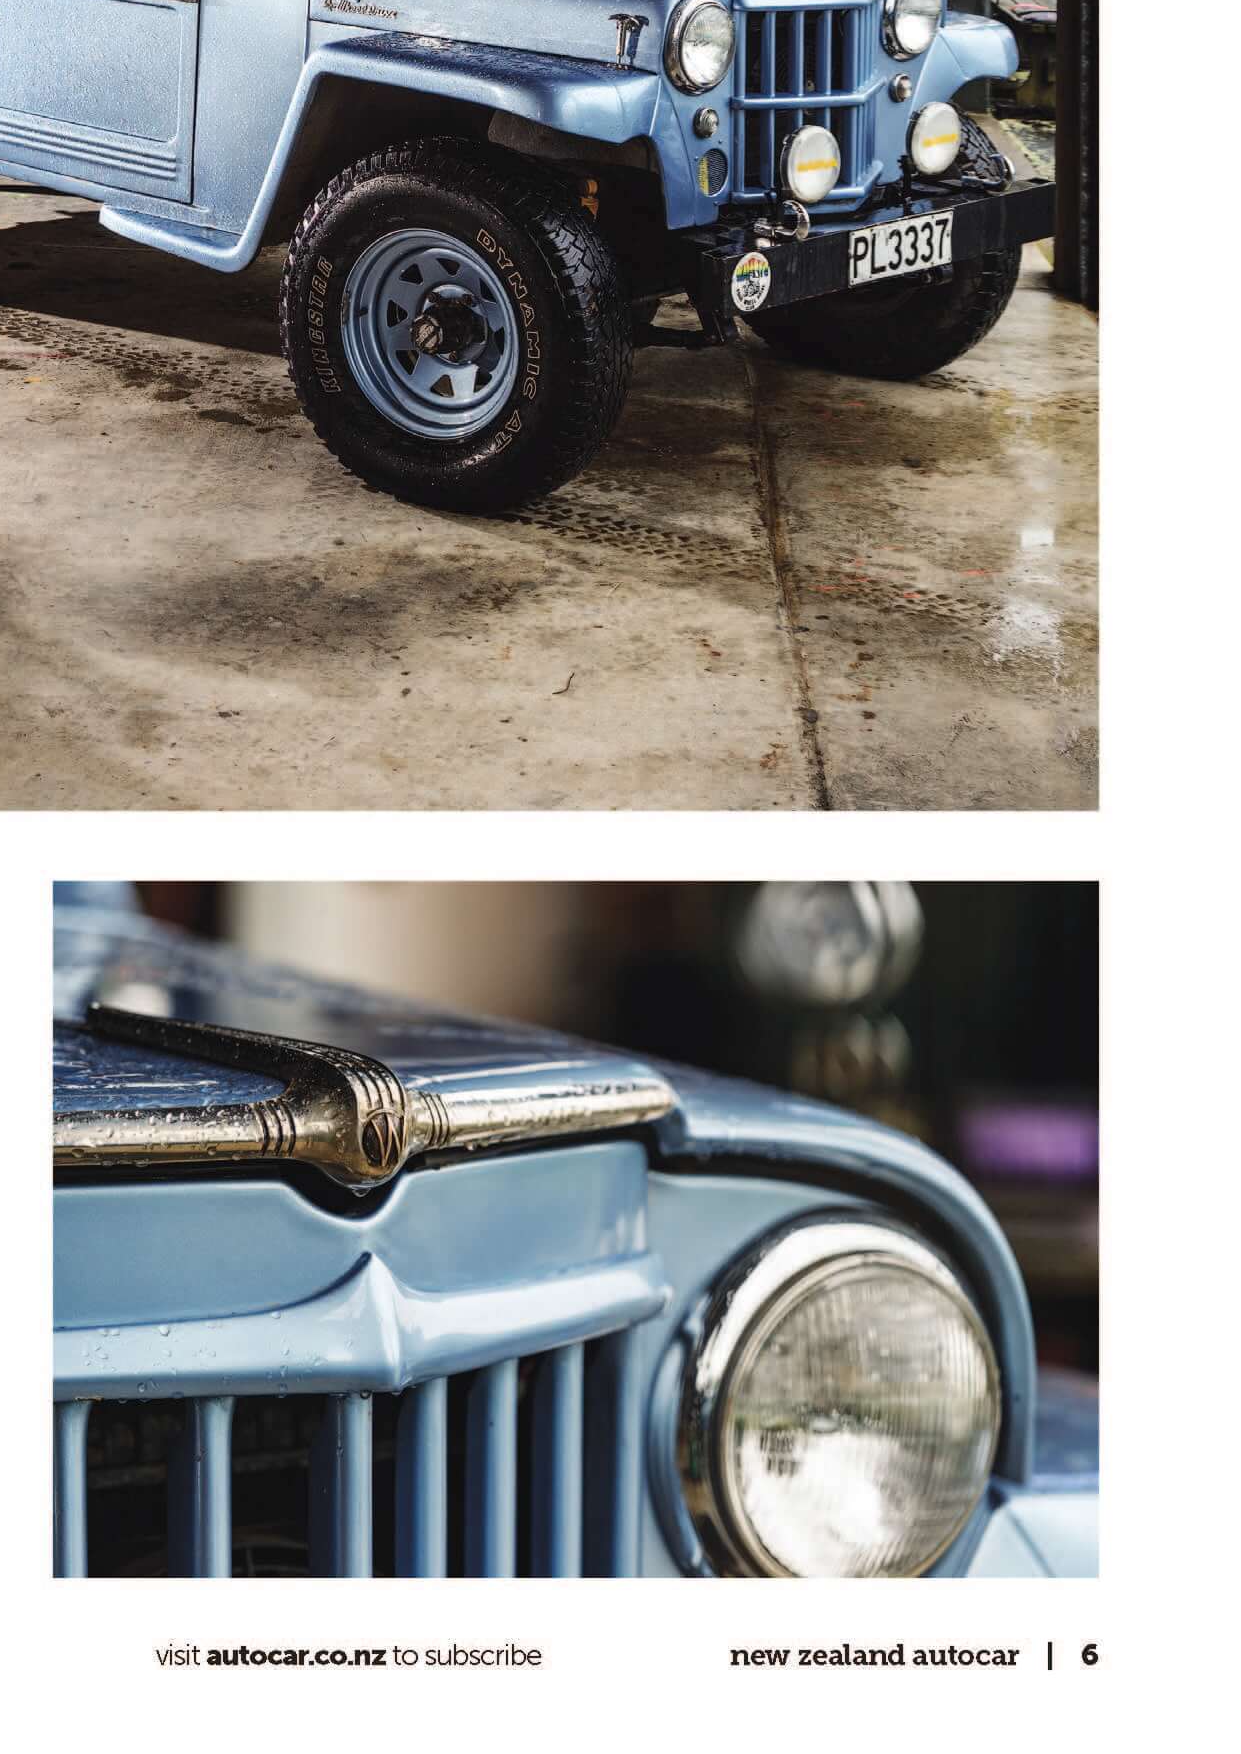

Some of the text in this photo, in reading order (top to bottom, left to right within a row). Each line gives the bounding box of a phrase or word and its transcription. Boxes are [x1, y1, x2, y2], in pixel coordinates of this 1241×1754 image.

[852, 218, 950, 280] PL3337
[476, 228, 542, 454] DYNAMIC AT
